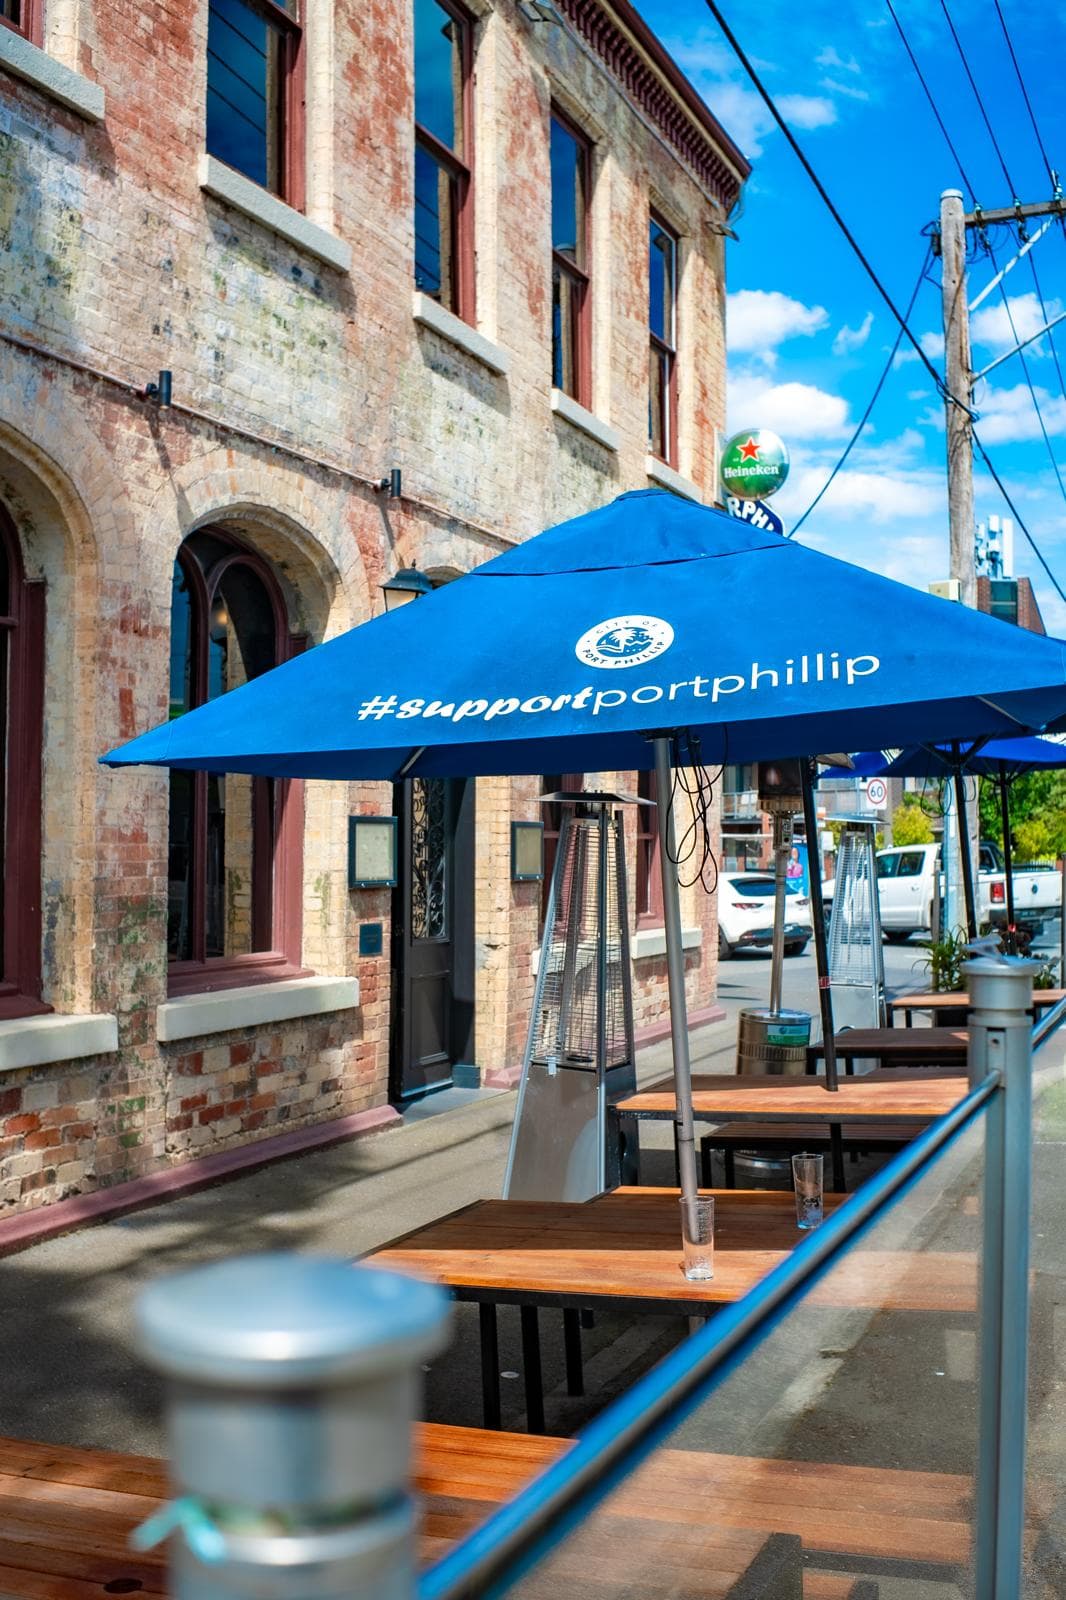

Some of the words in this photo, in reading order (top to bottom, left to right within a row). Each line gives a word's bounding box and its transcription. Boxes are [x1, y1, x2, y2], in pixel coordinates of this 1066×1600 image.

[724, 463, 779, 479] Heineken
[582, 648, 608, 664] PORT
[613, 641, 665, 665] PHILLIP
[870, 785, 883, 798] 60
